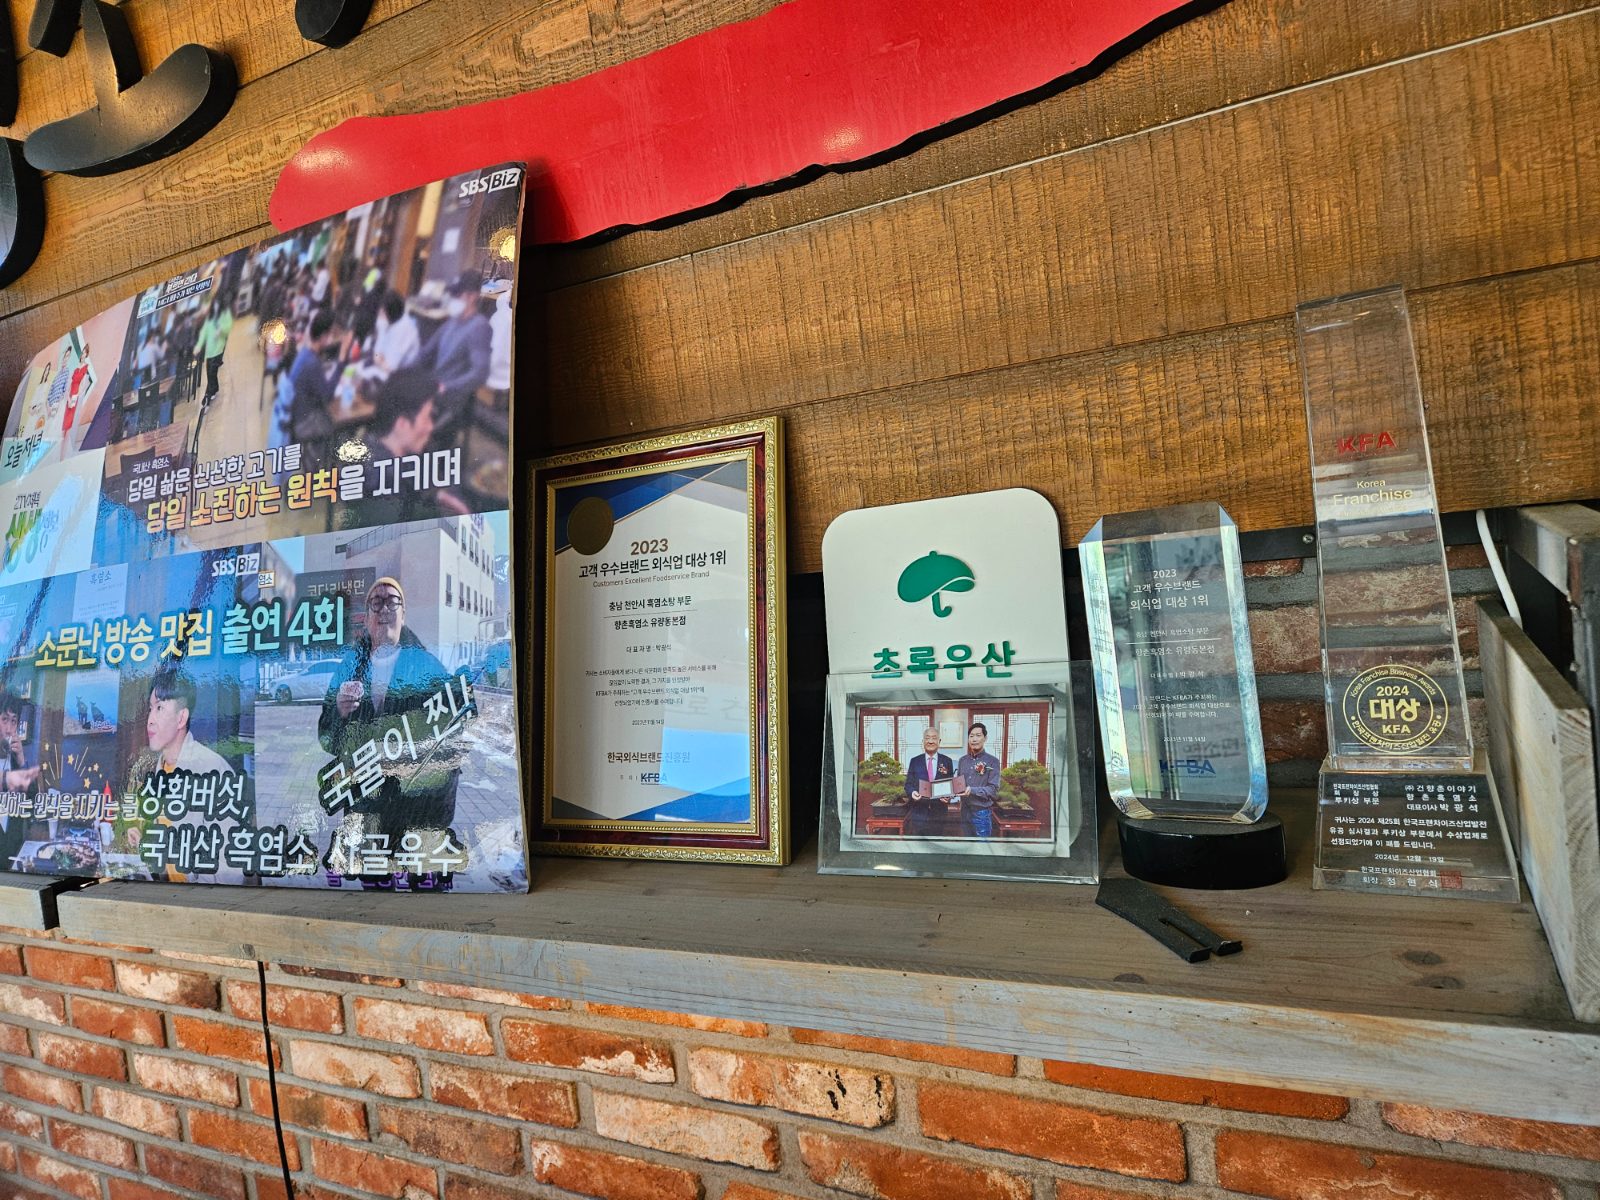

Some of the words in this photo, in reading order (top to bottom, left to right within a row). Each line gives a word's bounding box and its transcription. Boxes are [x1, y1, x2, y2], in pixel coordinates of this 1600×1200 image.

[459, 174, 490, 198] SBS
[490, 169, 520, 190] Biz
[1338, 431, 1398, 457] KFA
[128, 474, 158, 504] 당일
[160, 467, 190, 496] 삶은
[193, 453, 245, 490] 신선한
[247, 443, 302, 480] 고기를
[132, 462, 151, 475] 국내산
[152, 457, 170, 471] 흑염소
[146, 497, 187, 534] 당일
[190, 482, 281, 526] 소진하는
[287, 464, 364, 510] 원칙을
[372, 447, 461, 498] 지키며
[1356, 479, 1386, 489] Korea
[1333, 489, 1414, 506] Franchise
[631, 538, 669, 556] 2023
[212, 558, 236, 577] SBS
[237, 554, 259, 574] Biz
[578, 564, 598, 578] 고객
[600, 559, 650, 578] 우수브랜드
[652, 555, 683, 572] 외식업
[685, 551, 707, 568] 대상
[709, 549, 727, 566] 1위
[258, 574, 273, 586] 염소
[624, 576, 652, 585] Excellent
[690, 570, 710, 579] Brand
[1153, 568, 1177, 579] 2023
[1133, 583, 1152, 594] 고객
[1154, 579, 1202, 593] 우수브랜드
[609, 601, 623, 611] 충남
[624, 598, 645, 610] 천안시
[677, 595, 692, 606] 부문
[1130, 597, 1162, 611] 외식업
[1165, 595, 1188, 609] 대상
[1191, 594, 1209, 607] 1위
[35, 619, 102, 668] 소문난
[105, 617, 154, 665] 방송
[160, 609, 213, 659] 맛집
[221, 600, 281, 657] 출연
[287, 595, 344, 646] 4회
[614, 618, 649, 630] 향촌흑염소
[871, 641, 1016, 682] 초록우산
[1376, 685, 1410, 697] 2024
[1369, 698, 1421, 722] 대상
[1382, 724, 1412, 734] KFA
[322, 714, 418, 809] 국물이
[141, 774, 250, 820] 상황버섯,
[34, 792, 73, 820] 원칙을
[74, 792, 119, 822] 지키는
[141, 828, 221, 870] 국내산
[228, 828, 316, 872] 흑염소
[327, 833, 464, 877] 사골육수
[1374, 853, 1400, 862] 2024년
